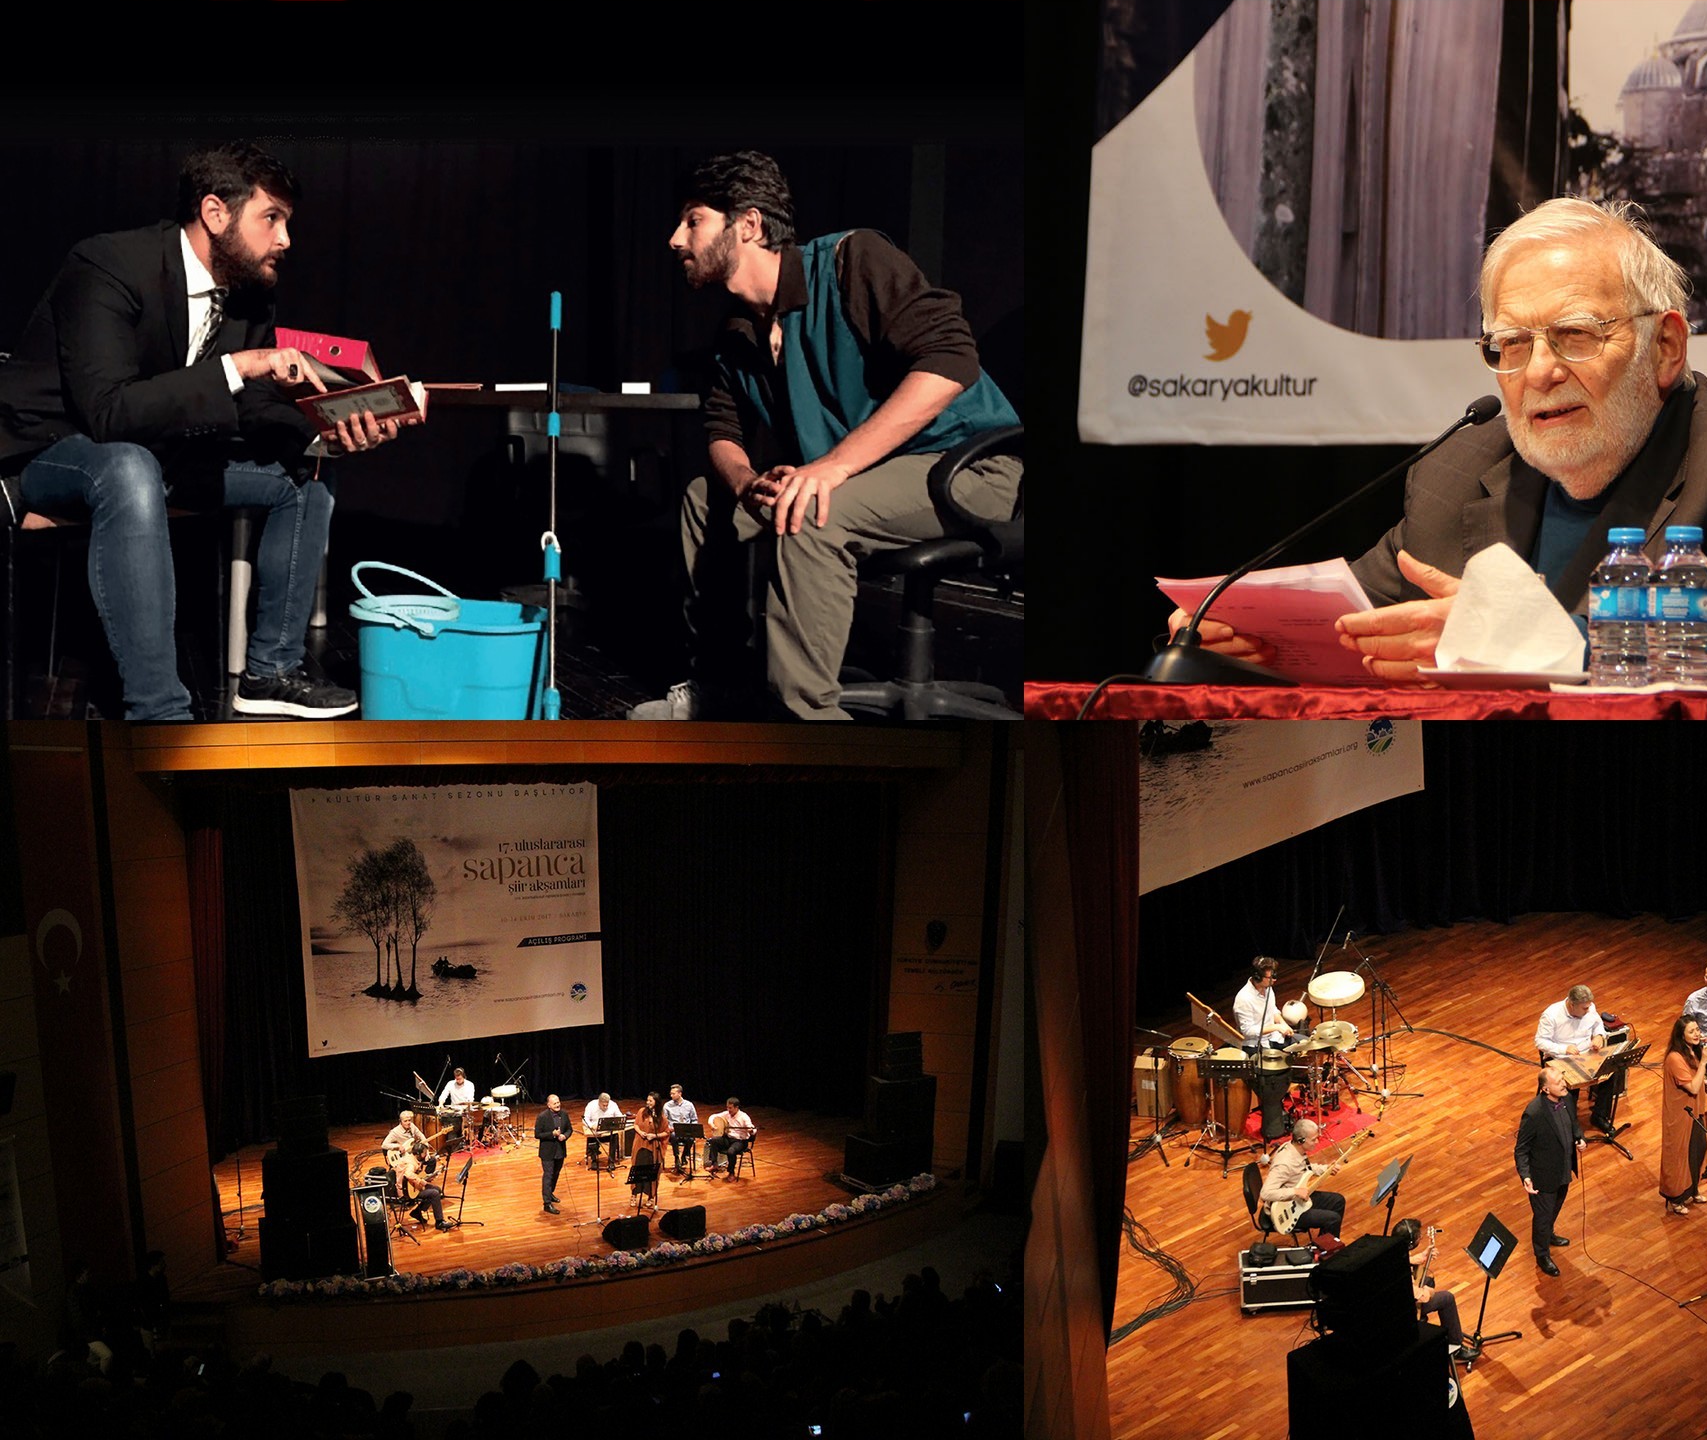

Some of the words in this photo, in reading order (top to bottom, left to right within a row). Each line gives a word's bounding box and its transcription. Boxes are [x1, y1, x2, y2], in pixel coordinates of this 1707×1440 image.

[1127, 374, 1318, 401] @sakaryakultur
[326, 794, 382, 803] KÜLTÜR
[392, 792, 438, 802] SANAT
[447, 790, 503, 799] SEZONU
[514, 787, 585, 797] BAŞLIYOR
[498, 842, 514, 854] 17.
[515, 838, 586, 852] uluslararası
[463, 852, 585, 885] sapanca
[508, 880, 528, 895] şiir
[529, 877, 586, 894] akşamları
[527, 937, 553, 946] AÇILIŞ
[553, 934, 587, 942] PROGRAMI
